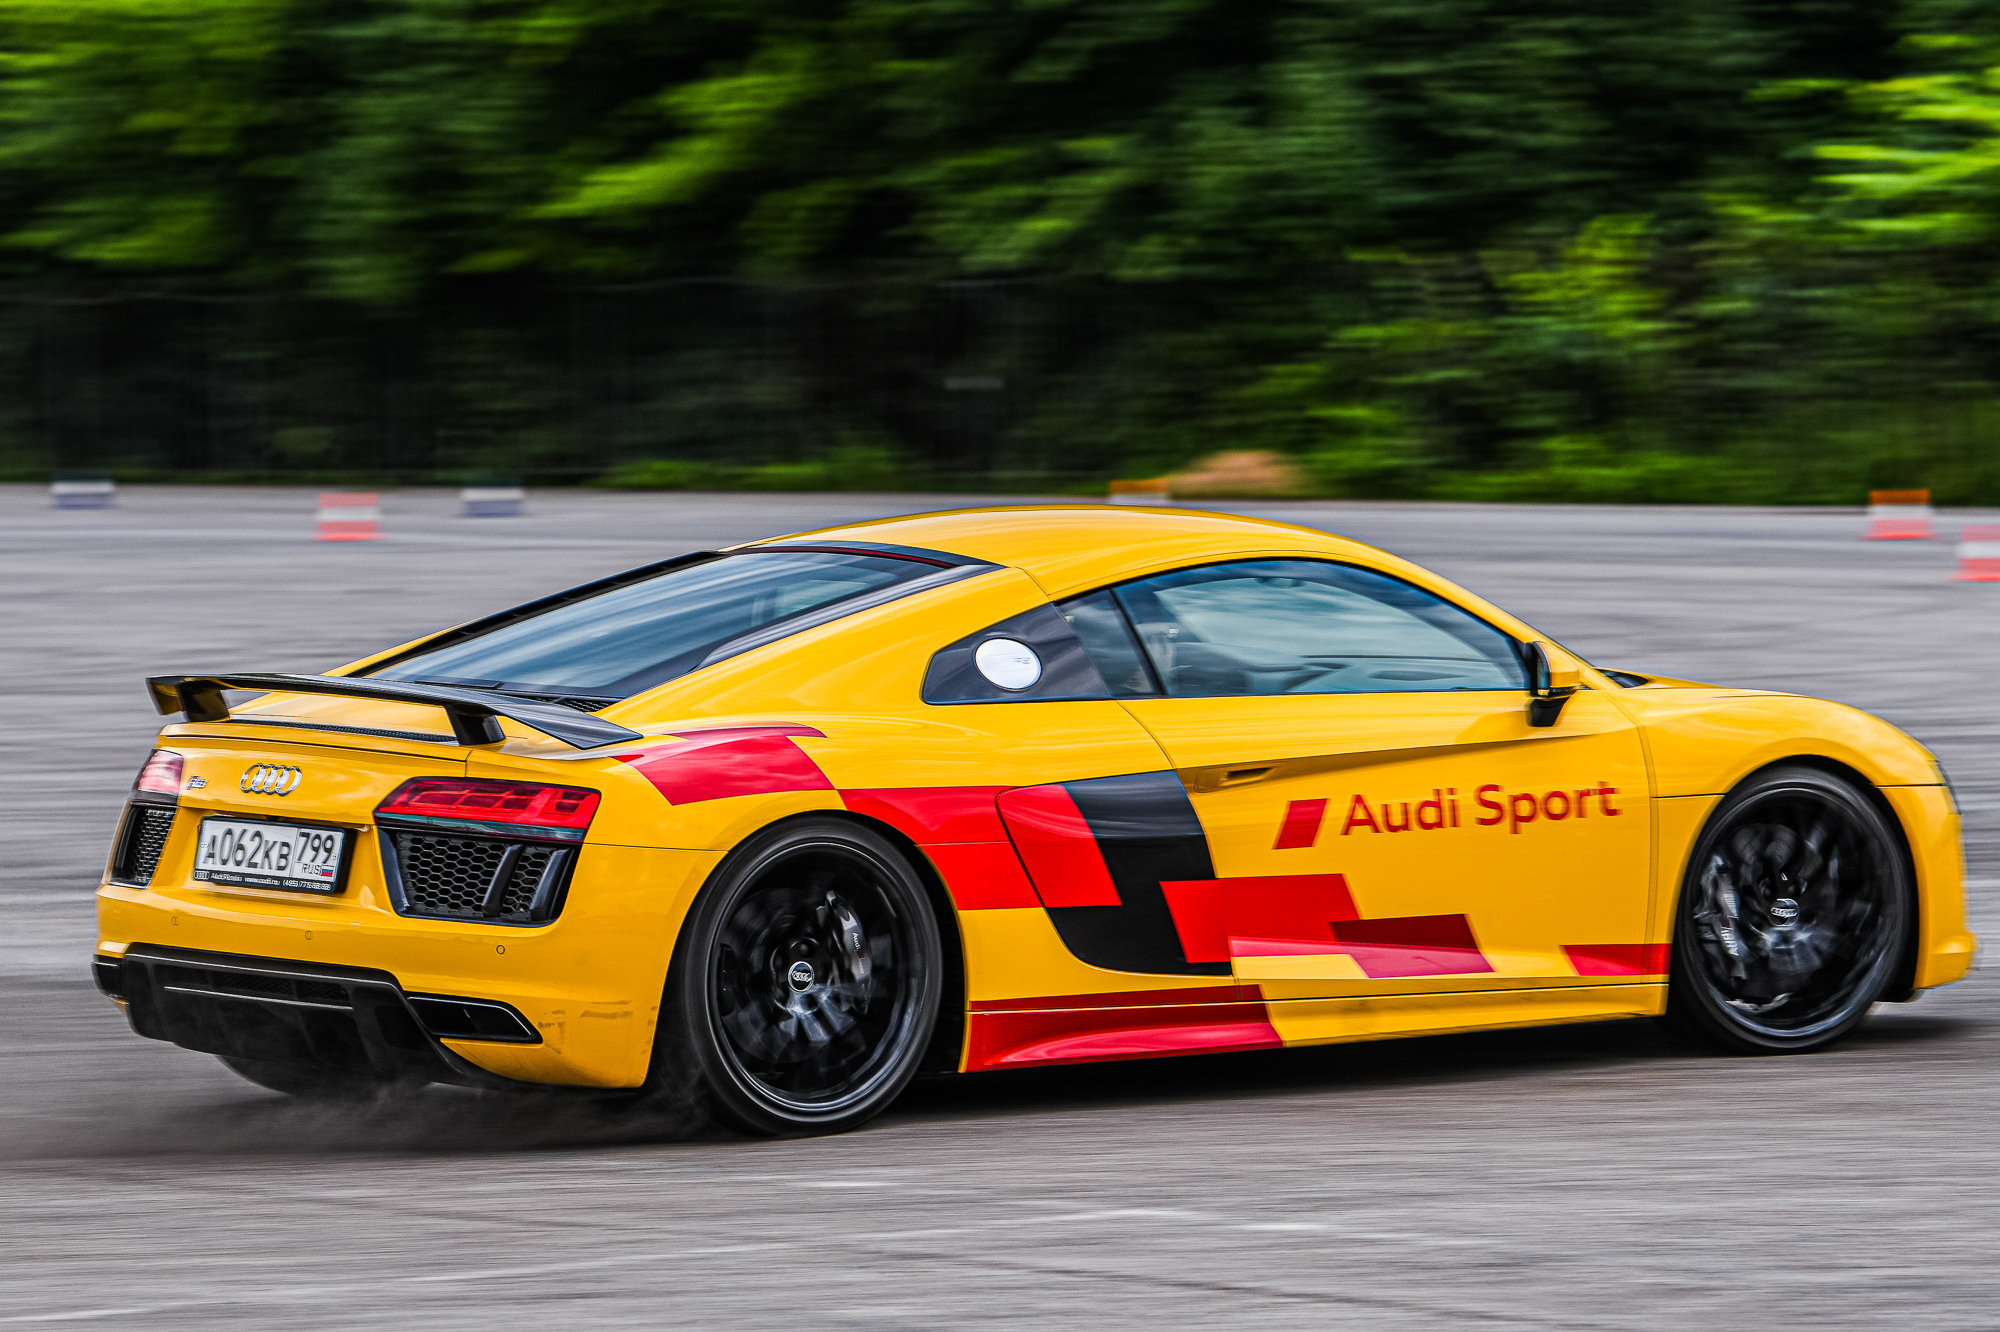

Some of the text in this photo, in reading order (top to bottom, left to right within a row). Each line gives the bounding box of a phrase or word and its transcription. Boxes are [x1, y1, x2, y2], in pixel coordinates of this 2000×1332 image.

[1340, 781, 1623, 836] Audi Sport
[297, 832, 334, 864] 799
[301, 864, 320, 876] RUS
